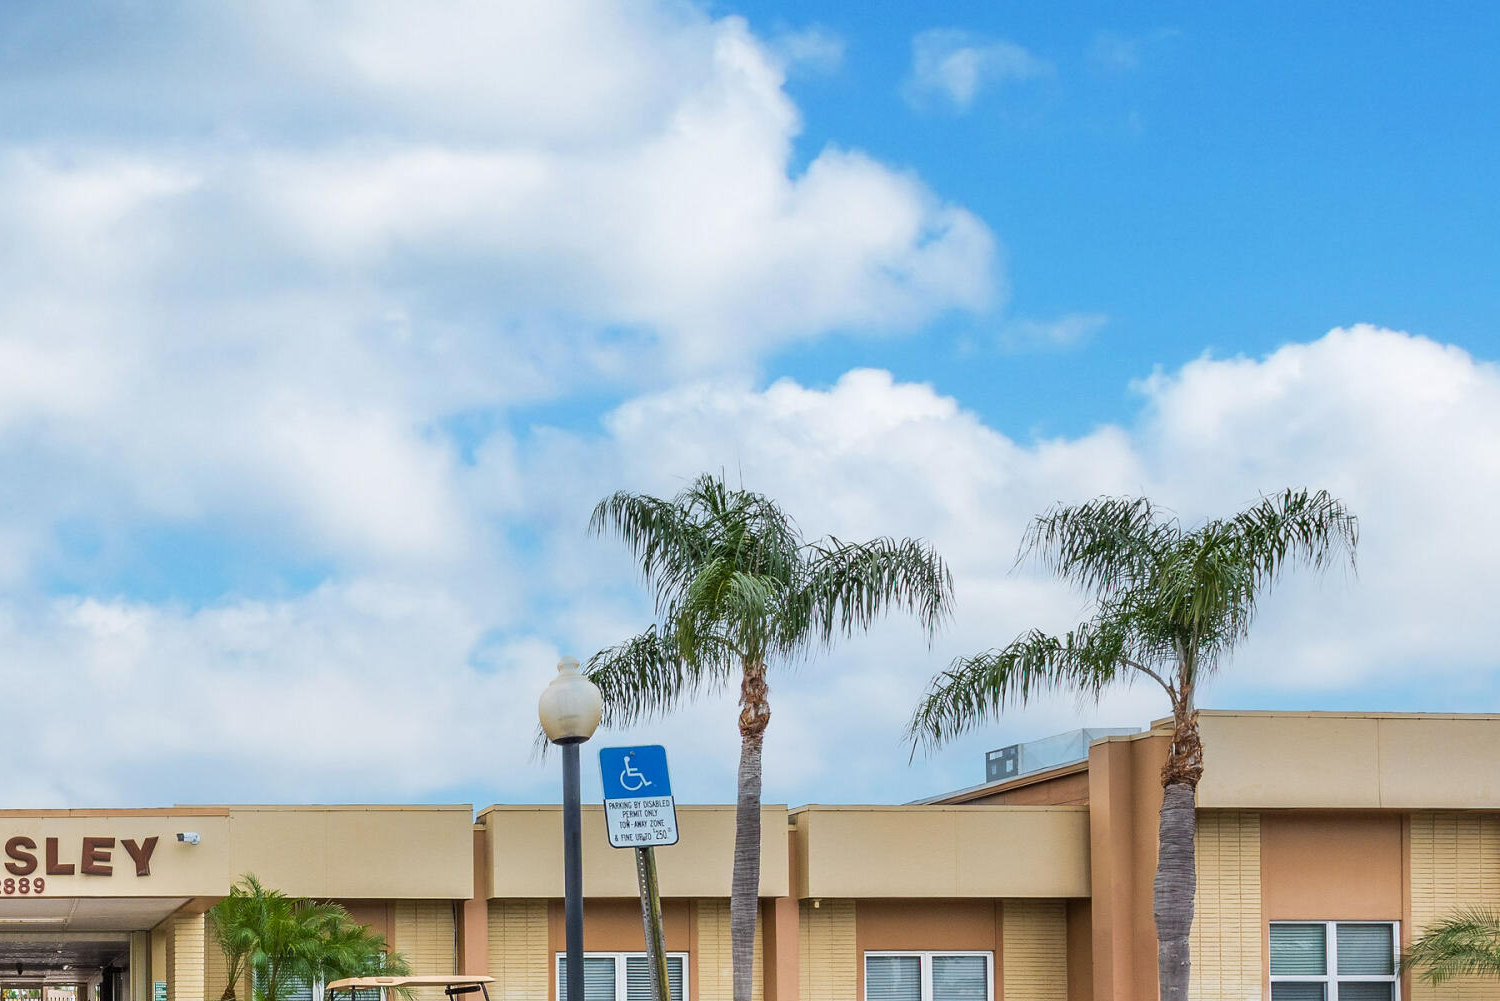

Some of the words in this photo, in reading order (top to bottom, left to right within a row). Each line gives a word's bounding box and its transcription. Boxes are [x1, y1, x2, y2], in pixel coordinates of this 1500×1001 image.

[609, 802, 632, 810] PARKING
[633, 801, 641, 809] BY
[643, 800, 670, 808] DISABLED
[622, 810, 642, 818] PERMIT
[620, 820, 647, 829] TOW-AWAY
[650, 819, 665, 827] ZONE
[620, 833, 633, 841] FINE
